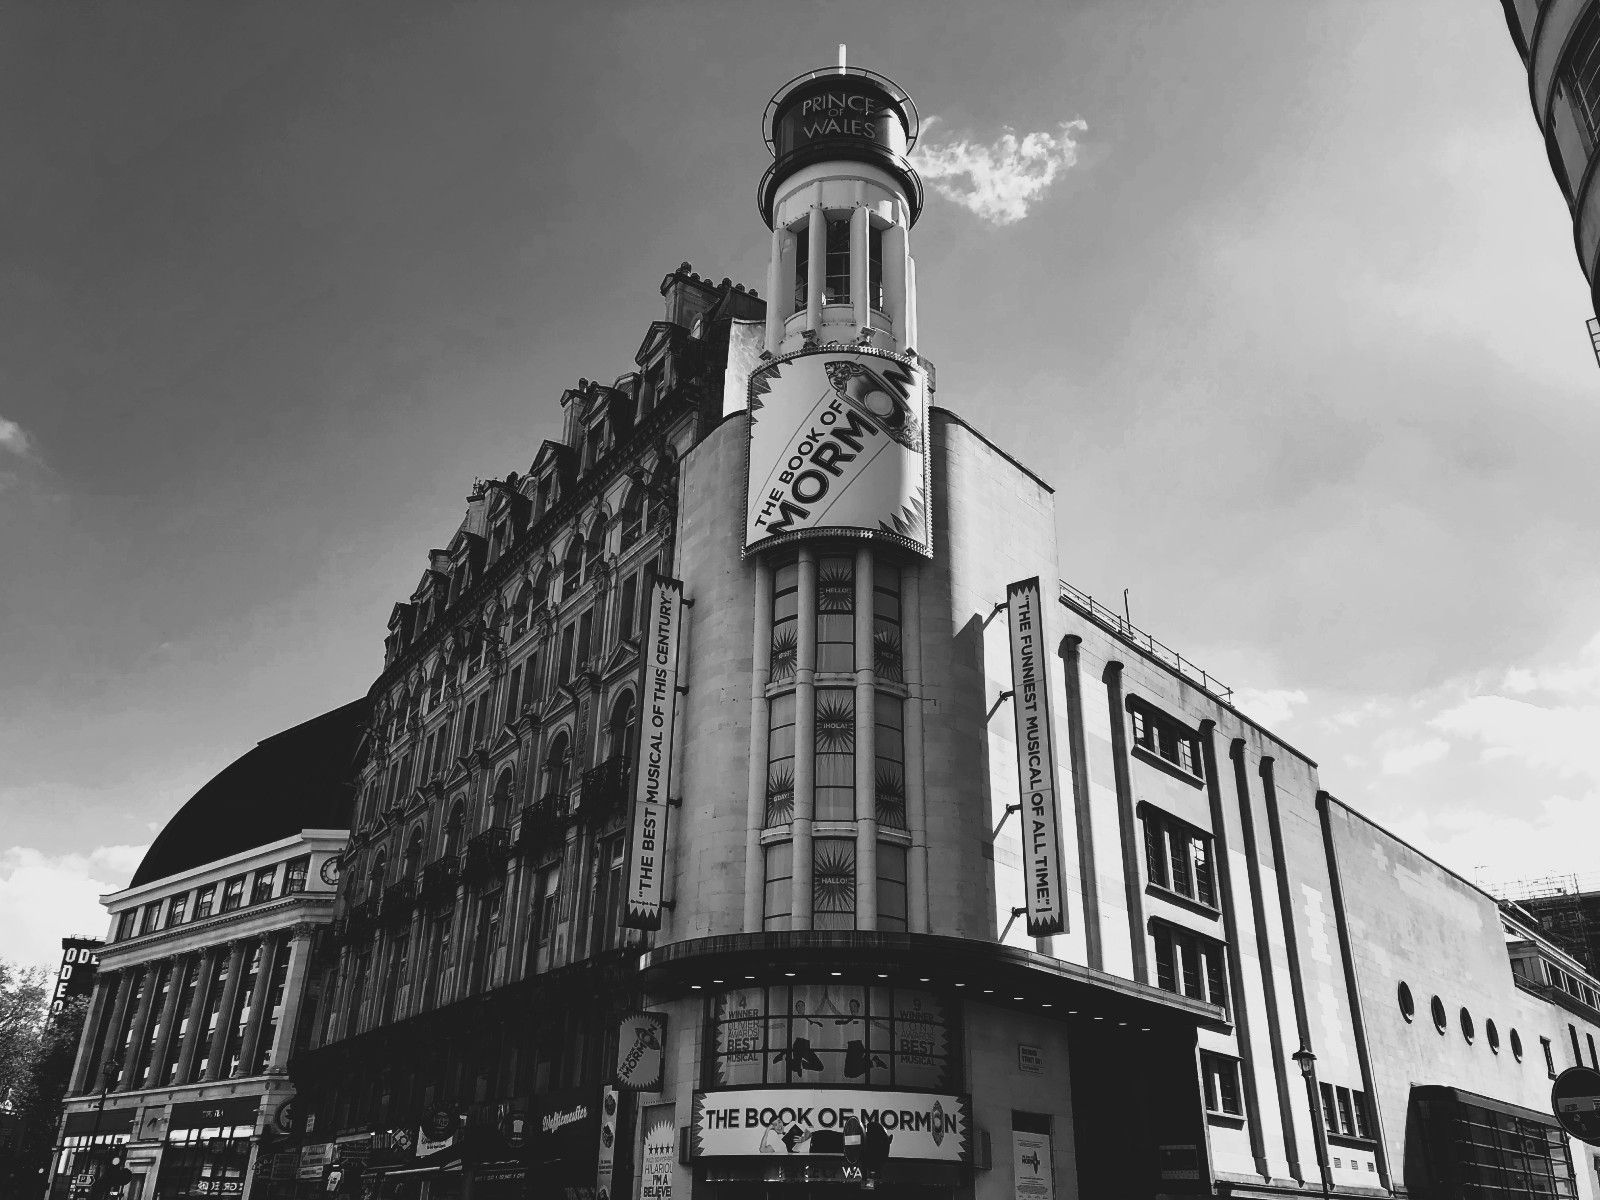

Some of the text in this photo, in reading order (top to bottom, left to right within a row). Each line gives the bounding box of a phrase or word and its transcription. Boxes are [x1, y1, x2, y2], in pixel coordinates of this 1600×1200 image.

[802, 93, 875, 116] PRINCE
[828, 108, 844, 117] OF
[803, 118, 876, 139] WALES
[755, 399, 843, 527] THE BOOK OF
[1020, 634, 1037, 711] FUNNIEST
[653, 668, 667, 702] THIS
[651, 704, 664, 728] OF
[1026, 716, 1042, 790] MUSICAL
[646, 731, 663, 803] MUSICAL
[1031, 792, 1044, 816] OF
[642, 807, 657, 851] BEST
[1032, 820, 1046, 854] ALL
[728, 1009, 759, 1019] WINNER
[728, 1020, 760, 1031] OLIVIER
[727, 1037, 759, 1052] BEST
[900, 1038, 935, 1055] BEST
[727, 1053, 759, 1063] MUSICAL
[900, 1055, 937, 1065] MUSICAL
[706, 1108, 740, 1129] THE
[745, 1107, 814, 1128] BOOK
[818, 1107, 854, 1128] OF
[652, 1174, 668, 1185] I'M A
